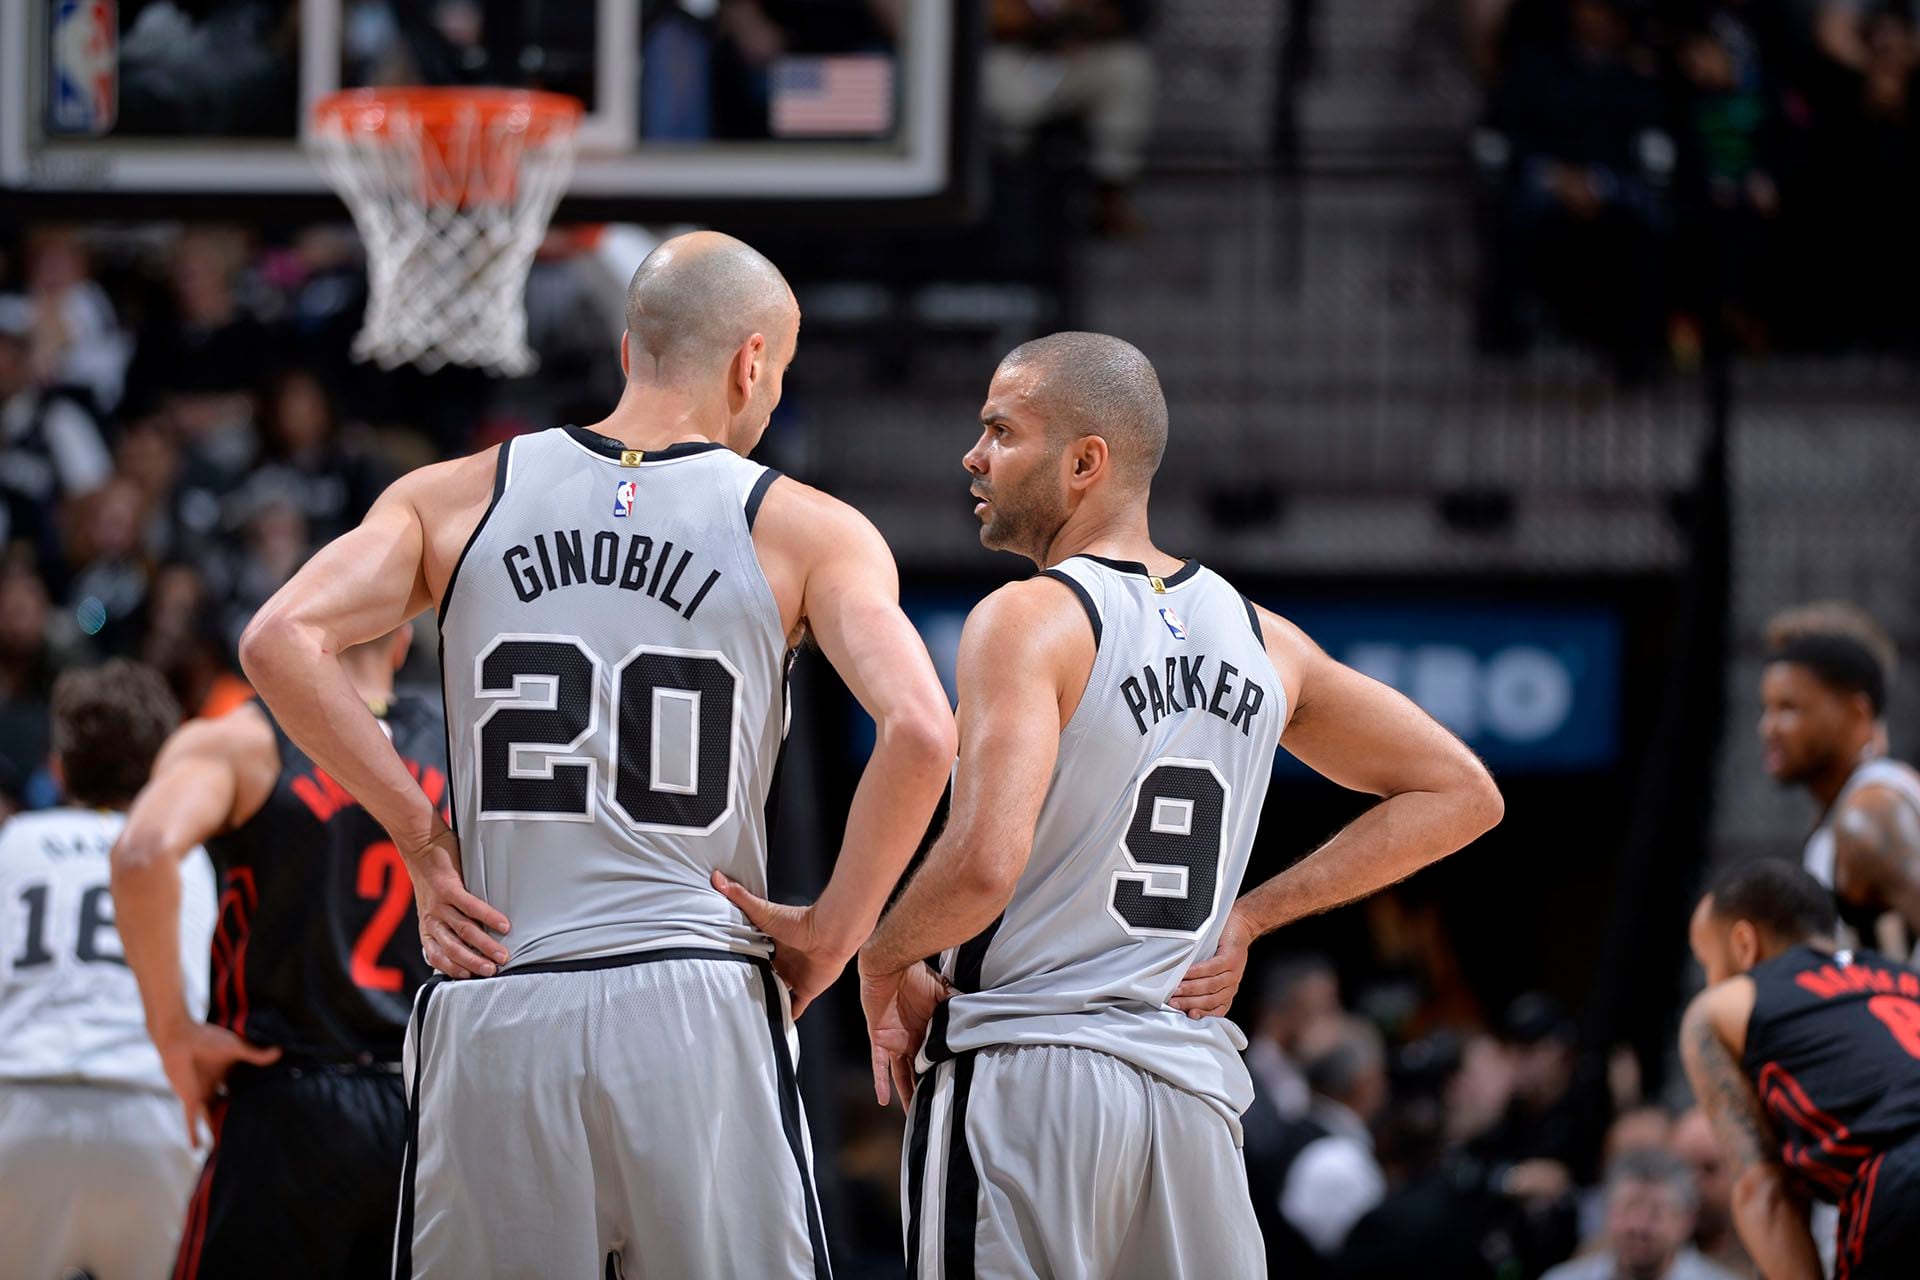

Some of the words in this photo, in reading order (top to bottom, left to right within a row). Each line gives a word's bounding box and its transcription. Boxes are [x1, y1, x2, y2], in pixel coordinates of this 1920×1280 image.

[503, 530, 721, 620] GINOBILI
[474, 633, 744, 837] 20
[1120, 655, 1265, 737] PARKER
[1106, 757, 1231, 939] 9
